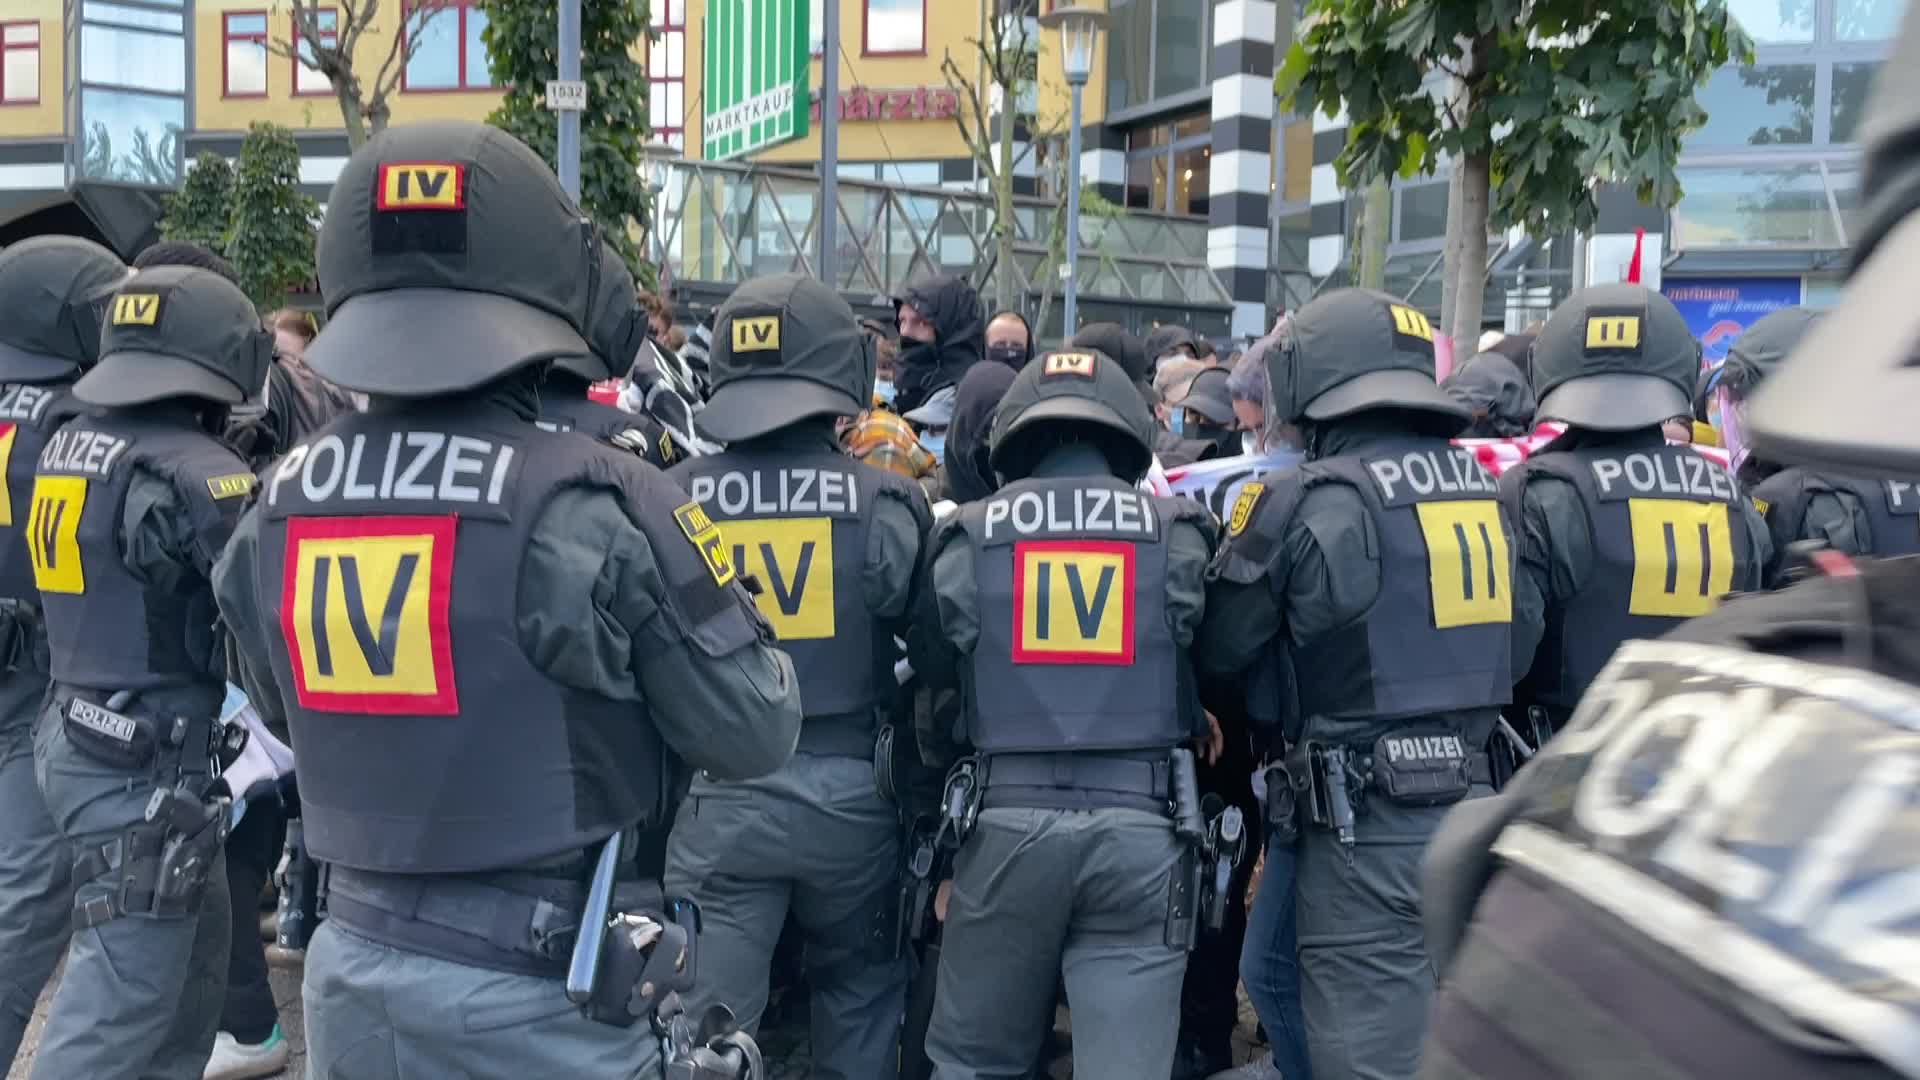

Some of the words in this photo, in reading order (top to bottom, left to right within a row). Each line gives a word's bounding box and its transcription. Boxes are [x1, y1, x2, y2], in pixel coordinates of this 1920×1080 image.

[706, 88, 791, 137] MARKTKAUF
[396, 170, 448, 199] IV
[119, 298, 153, 320] IV
[738, 322, 774, 345] IV
[1056, 354, 1083, 369] IV
[41, 430, 126, 476] OLIZEI
[268, 431, 514, 506] POLIZEI
[1592, 453, 1738, 502] POLIZEI
[690, 468, 859, 517] POLIZEI
[984, 487, 1155, 540] POLIZEI
[34, 497, 67, 570] IV
[311, 553, 420, 678] IV
[1036, 560, 1116, 642] IV
[72, 701, 133, 739] POLIZEI
[1387, 736, 1463, 762] POLIZEI
